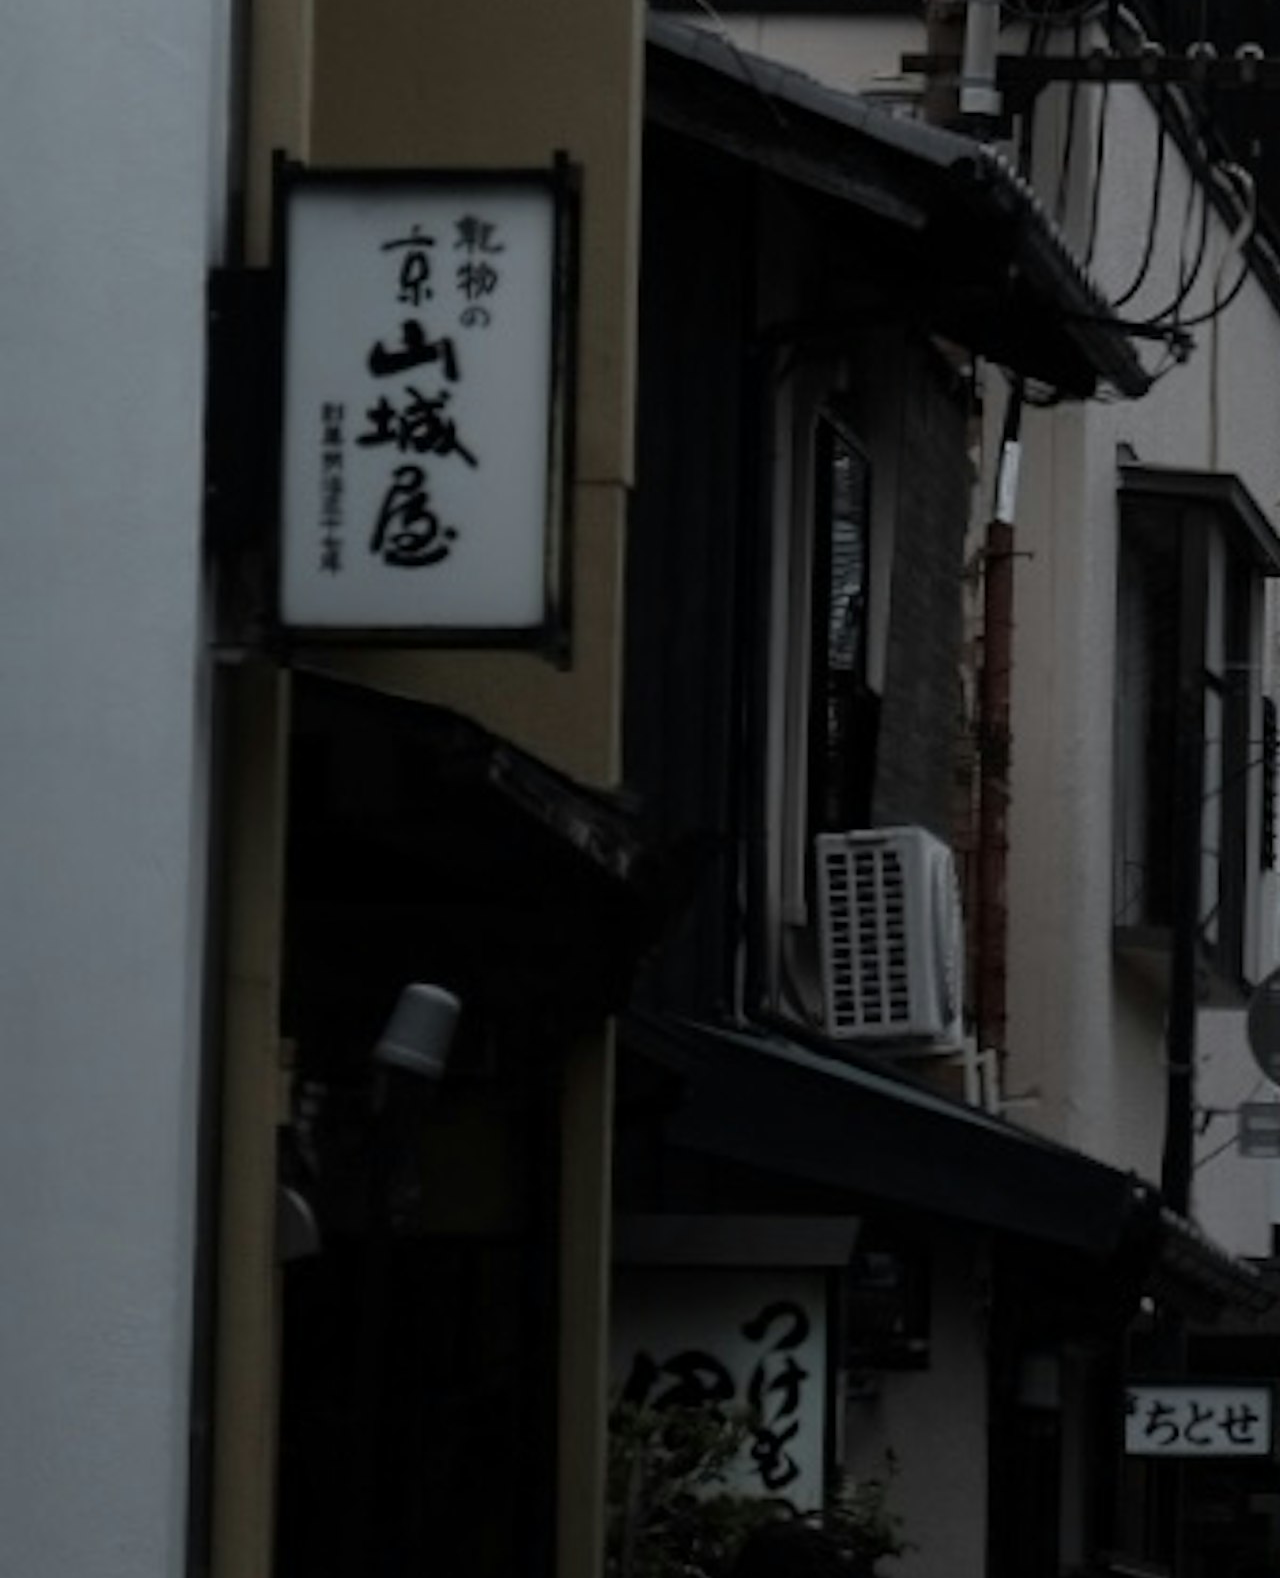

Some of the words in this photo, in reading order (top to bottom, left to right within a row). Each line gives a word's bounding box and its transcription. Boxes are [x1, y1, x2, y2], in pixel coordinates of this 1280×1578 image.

[452, 213, 504, 329] 乾物の
[356, 224, 478, 569] 京山城屋
[1145, 1399, 1258, 1445] ちとせ
